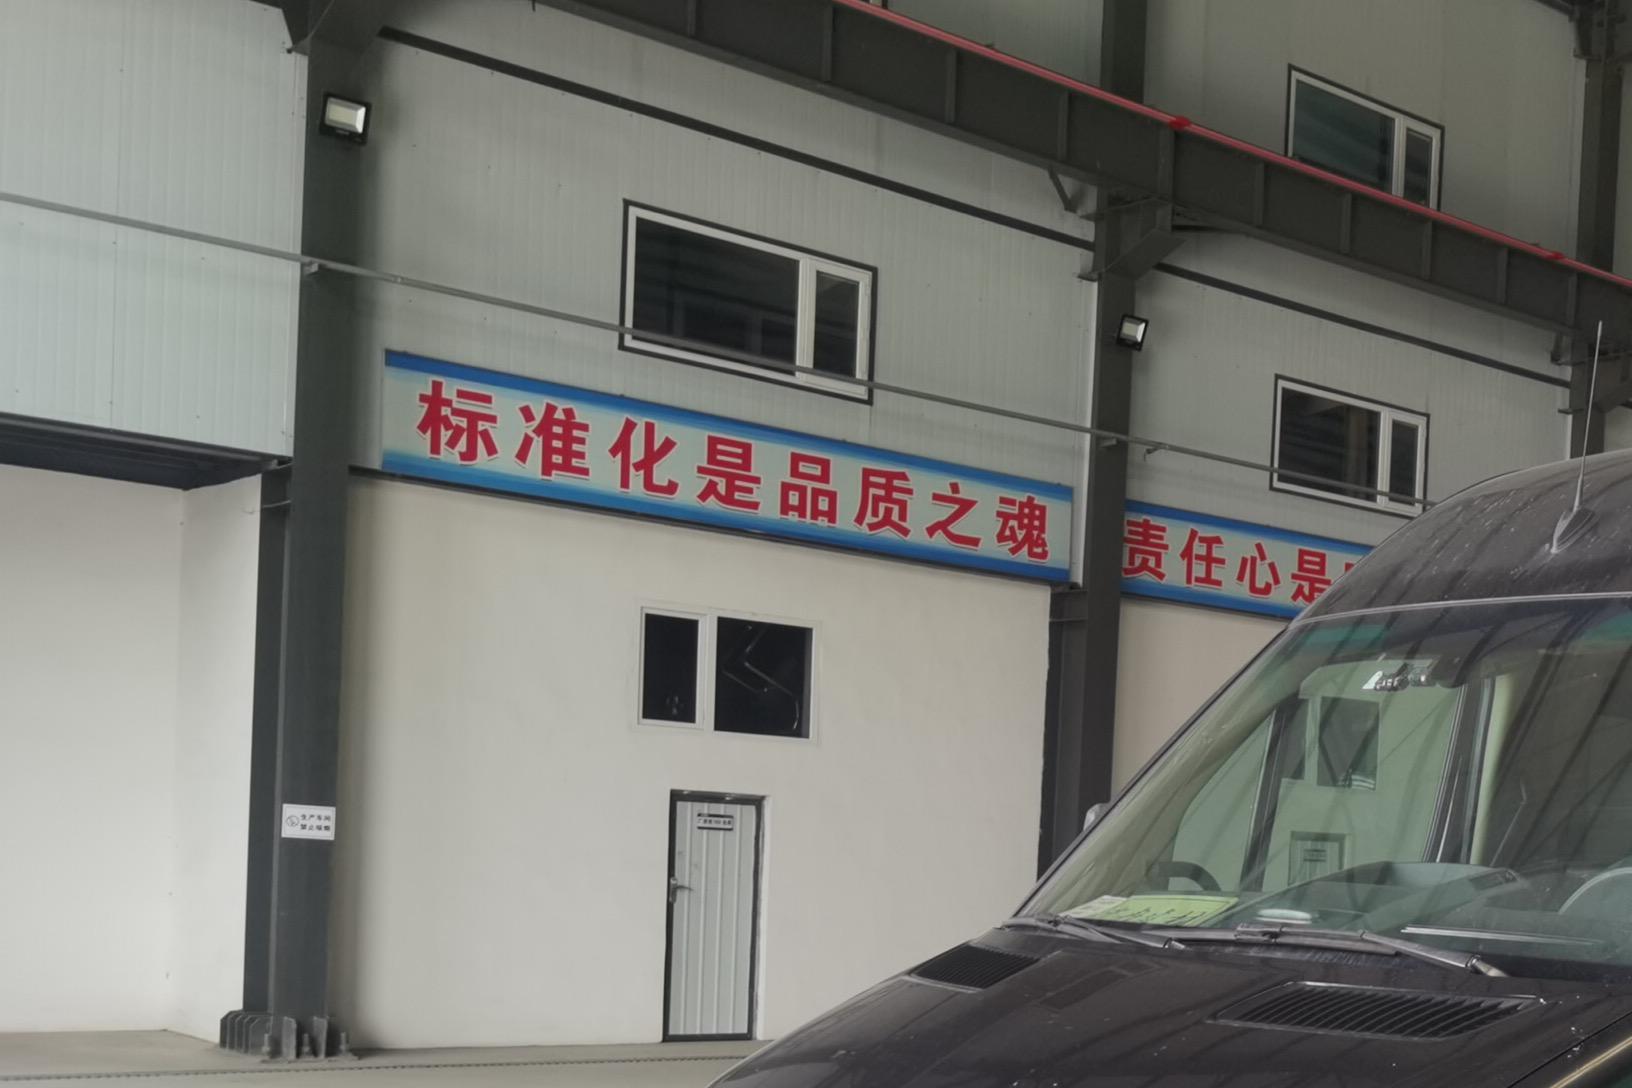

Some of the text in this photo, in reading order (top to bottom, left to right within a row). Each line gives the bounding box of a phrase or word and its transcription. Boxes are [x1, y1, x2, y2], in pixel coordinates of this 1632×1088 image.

[416, 379, 1051, 562] 标准化是品质之魂
[1120, 517, 1356, 605] 责任心是
